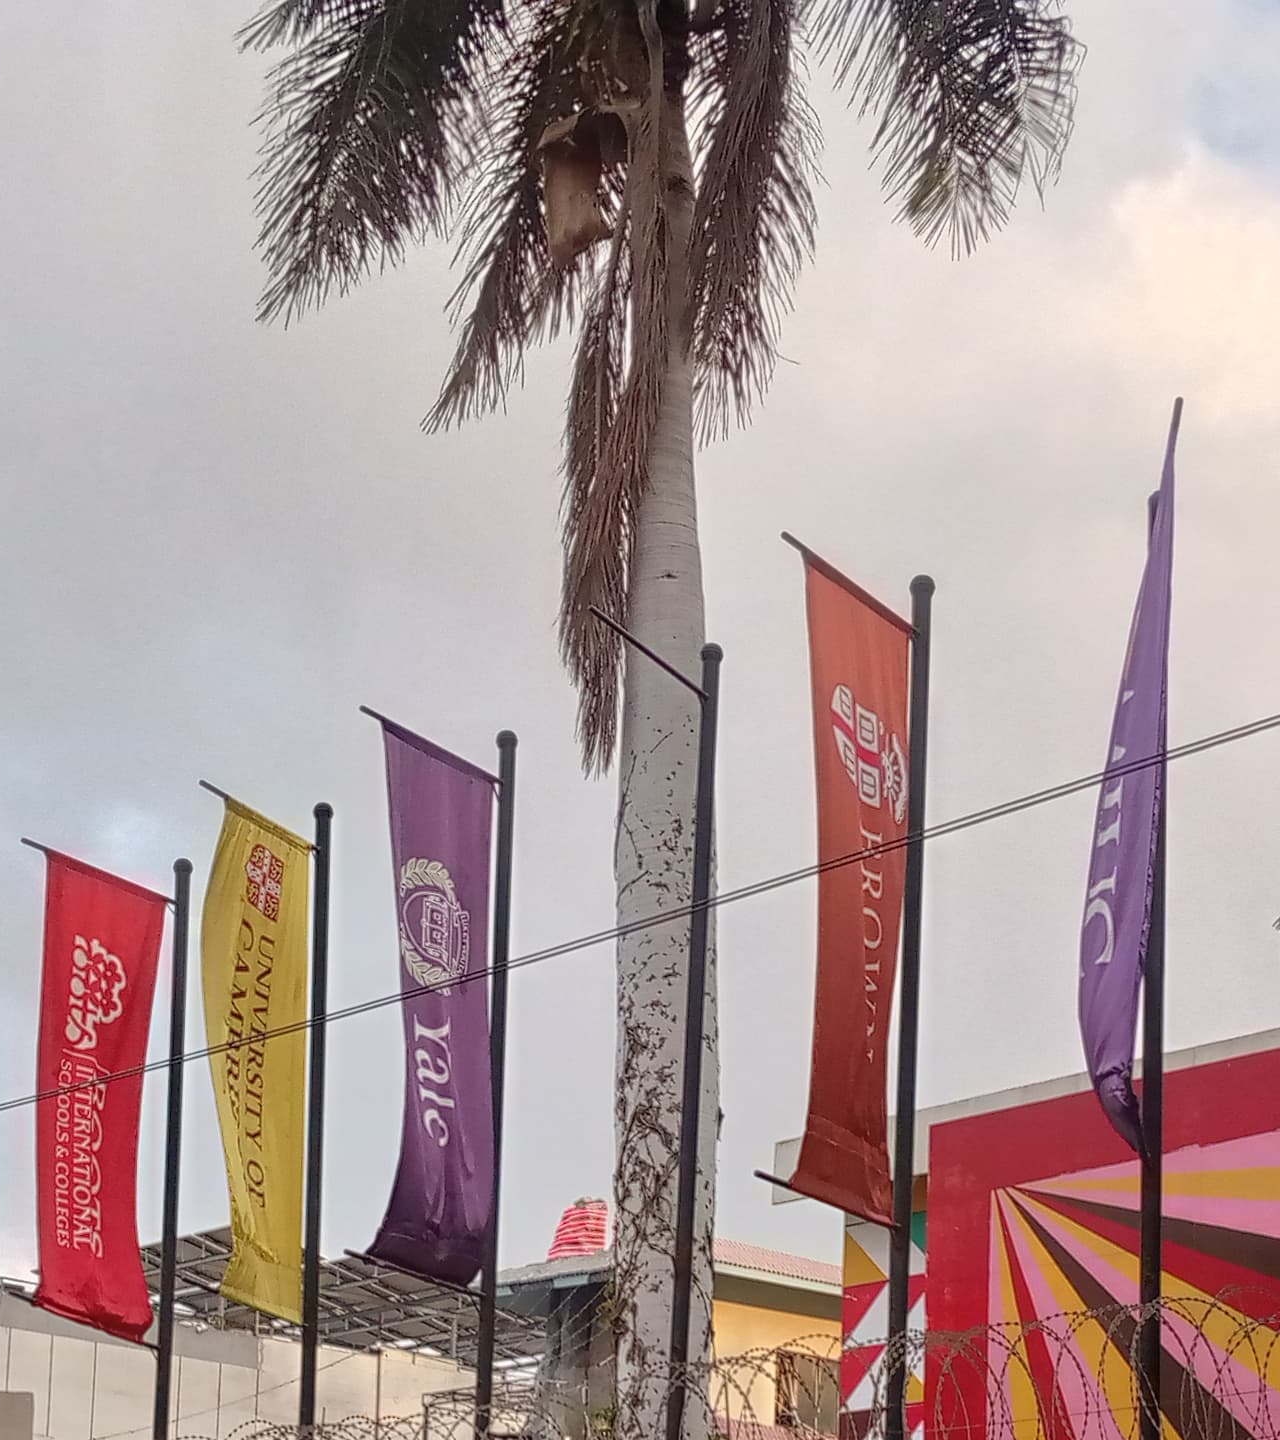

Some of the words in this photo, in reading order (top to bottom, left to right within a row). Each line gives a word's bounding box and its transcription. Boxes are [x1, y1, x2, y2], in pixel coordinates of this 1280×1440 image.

[55, 1058, 72, 1143] SCHOOLS
[244, 934, 276, 1151] UNIVERSITY
[54, 1160, 71, 1249] COLLEGES
[71, 1063, 95, 1251] INTERNATIONAL
